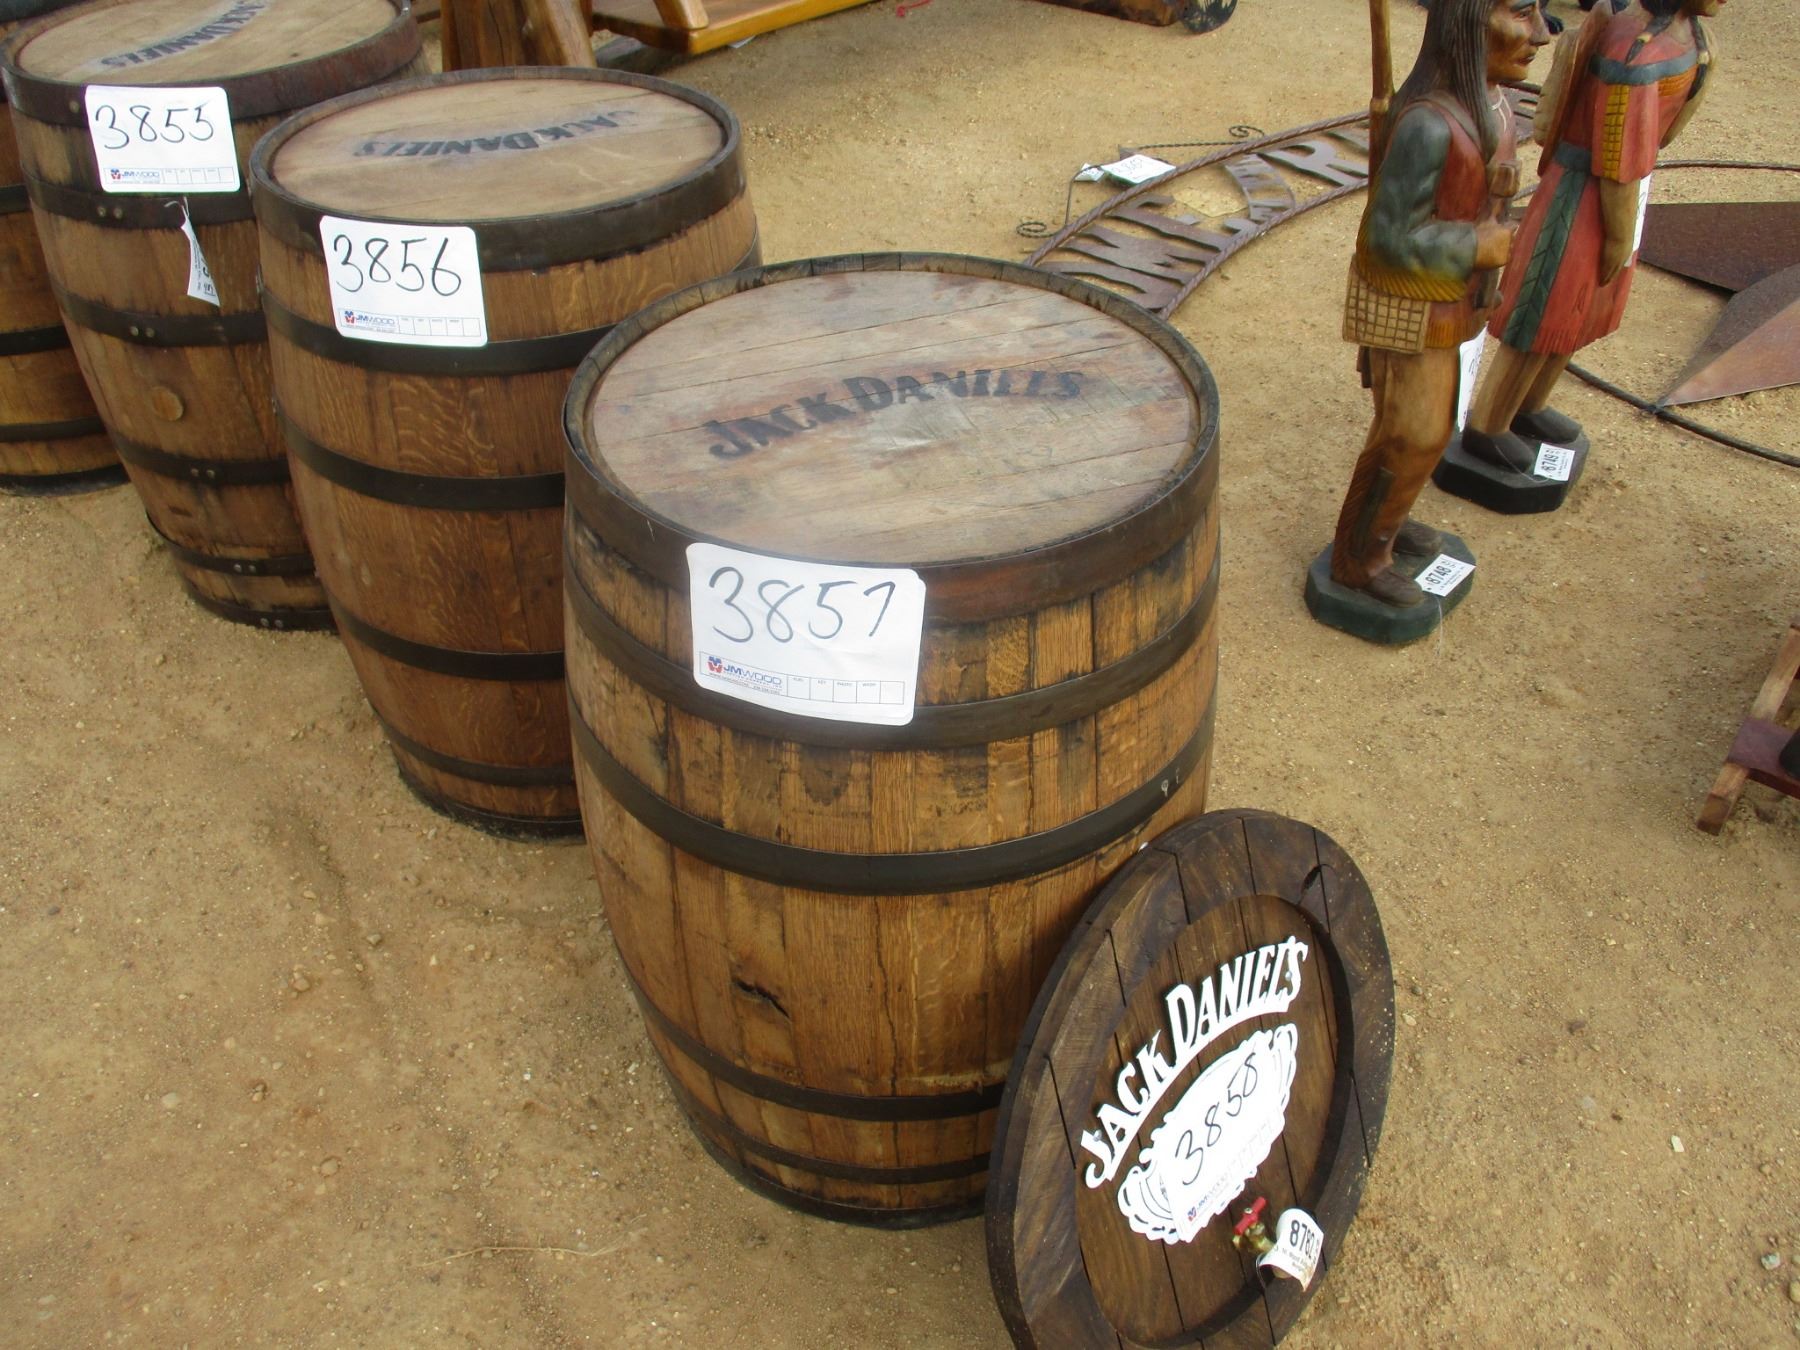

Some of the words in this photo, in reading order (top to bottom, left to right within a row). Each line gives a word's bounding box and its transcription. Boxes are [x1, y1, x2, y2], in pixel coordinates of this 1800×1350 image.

[95, 102, 214, 150] 3855
[353, 132, 540, 156] DANIELS
[333, 234, 462, 297] 3856
[702, 391, 857, 460] JACK
[708, 566, 896, 644] 3857
[723, 664, 782, 685] JMWOOD
[1080, 1029, 1177, 1189] JACK
[1175, 1052, 1258, 1186] 3858
